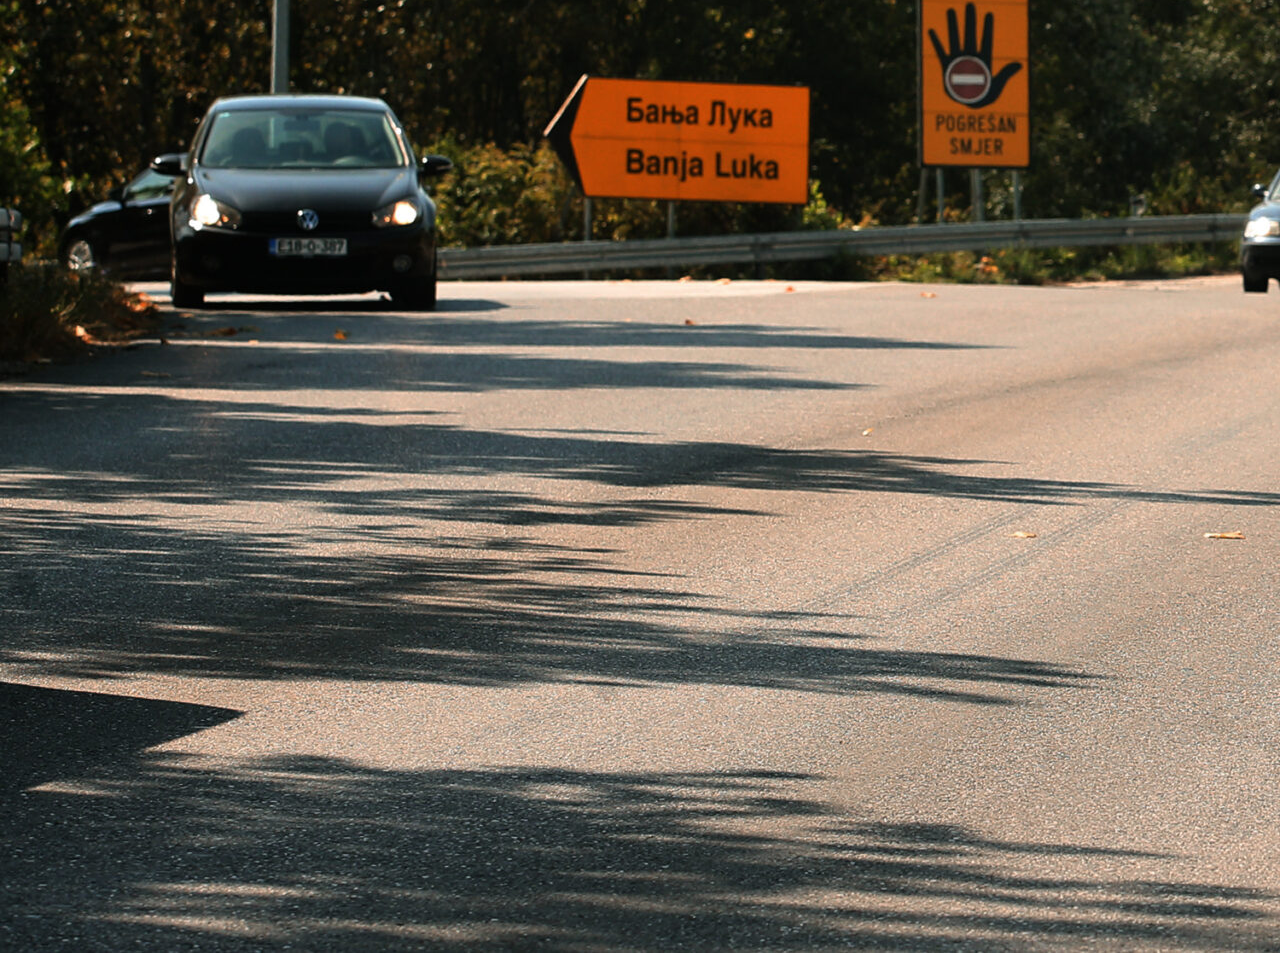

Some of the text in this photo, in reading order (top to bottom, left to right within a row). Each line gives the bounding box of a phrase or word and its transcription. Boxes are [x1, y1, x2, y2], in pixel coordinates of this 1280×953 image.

[626, 97, 773, 133] Бања Лука
[935, 113, 1017, 134] POGREŠAN
[950, 137, 1004, 156] SMJER
[626, 148, 779, 182] Banja Luka
